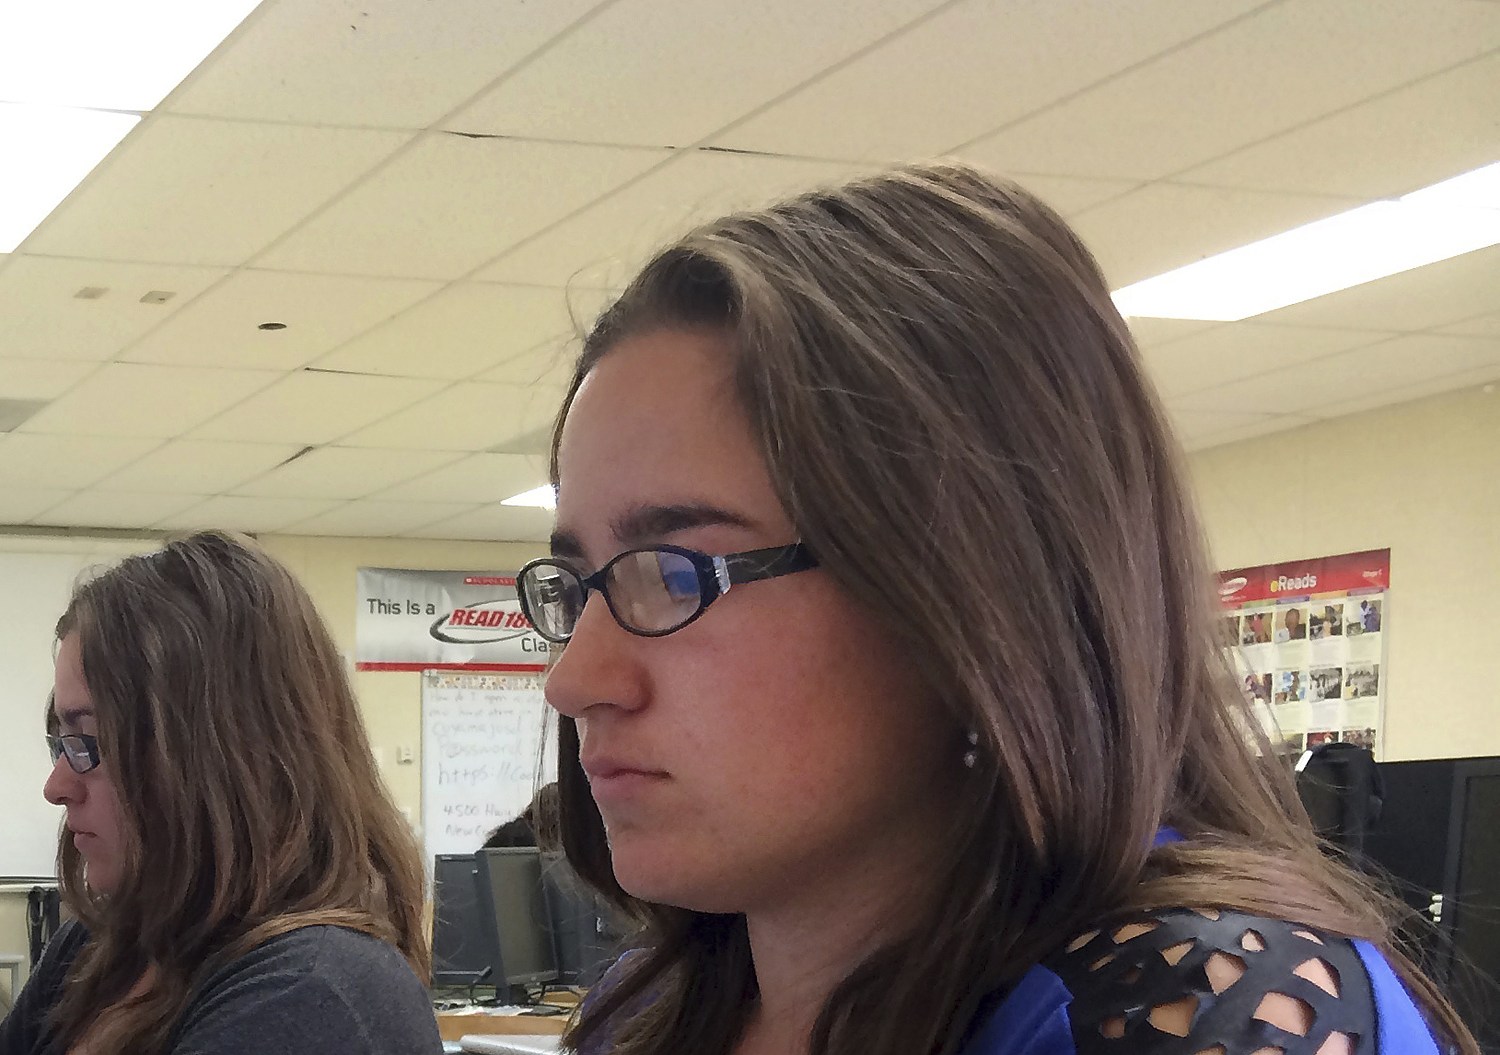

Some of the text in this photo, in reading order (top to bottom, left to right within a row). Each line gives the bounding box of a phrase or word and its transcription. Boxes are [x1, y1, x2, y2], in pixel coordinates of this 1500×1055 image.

[366, 598, 436, 615] This Is a
[448, 608, 504, 627] READ
